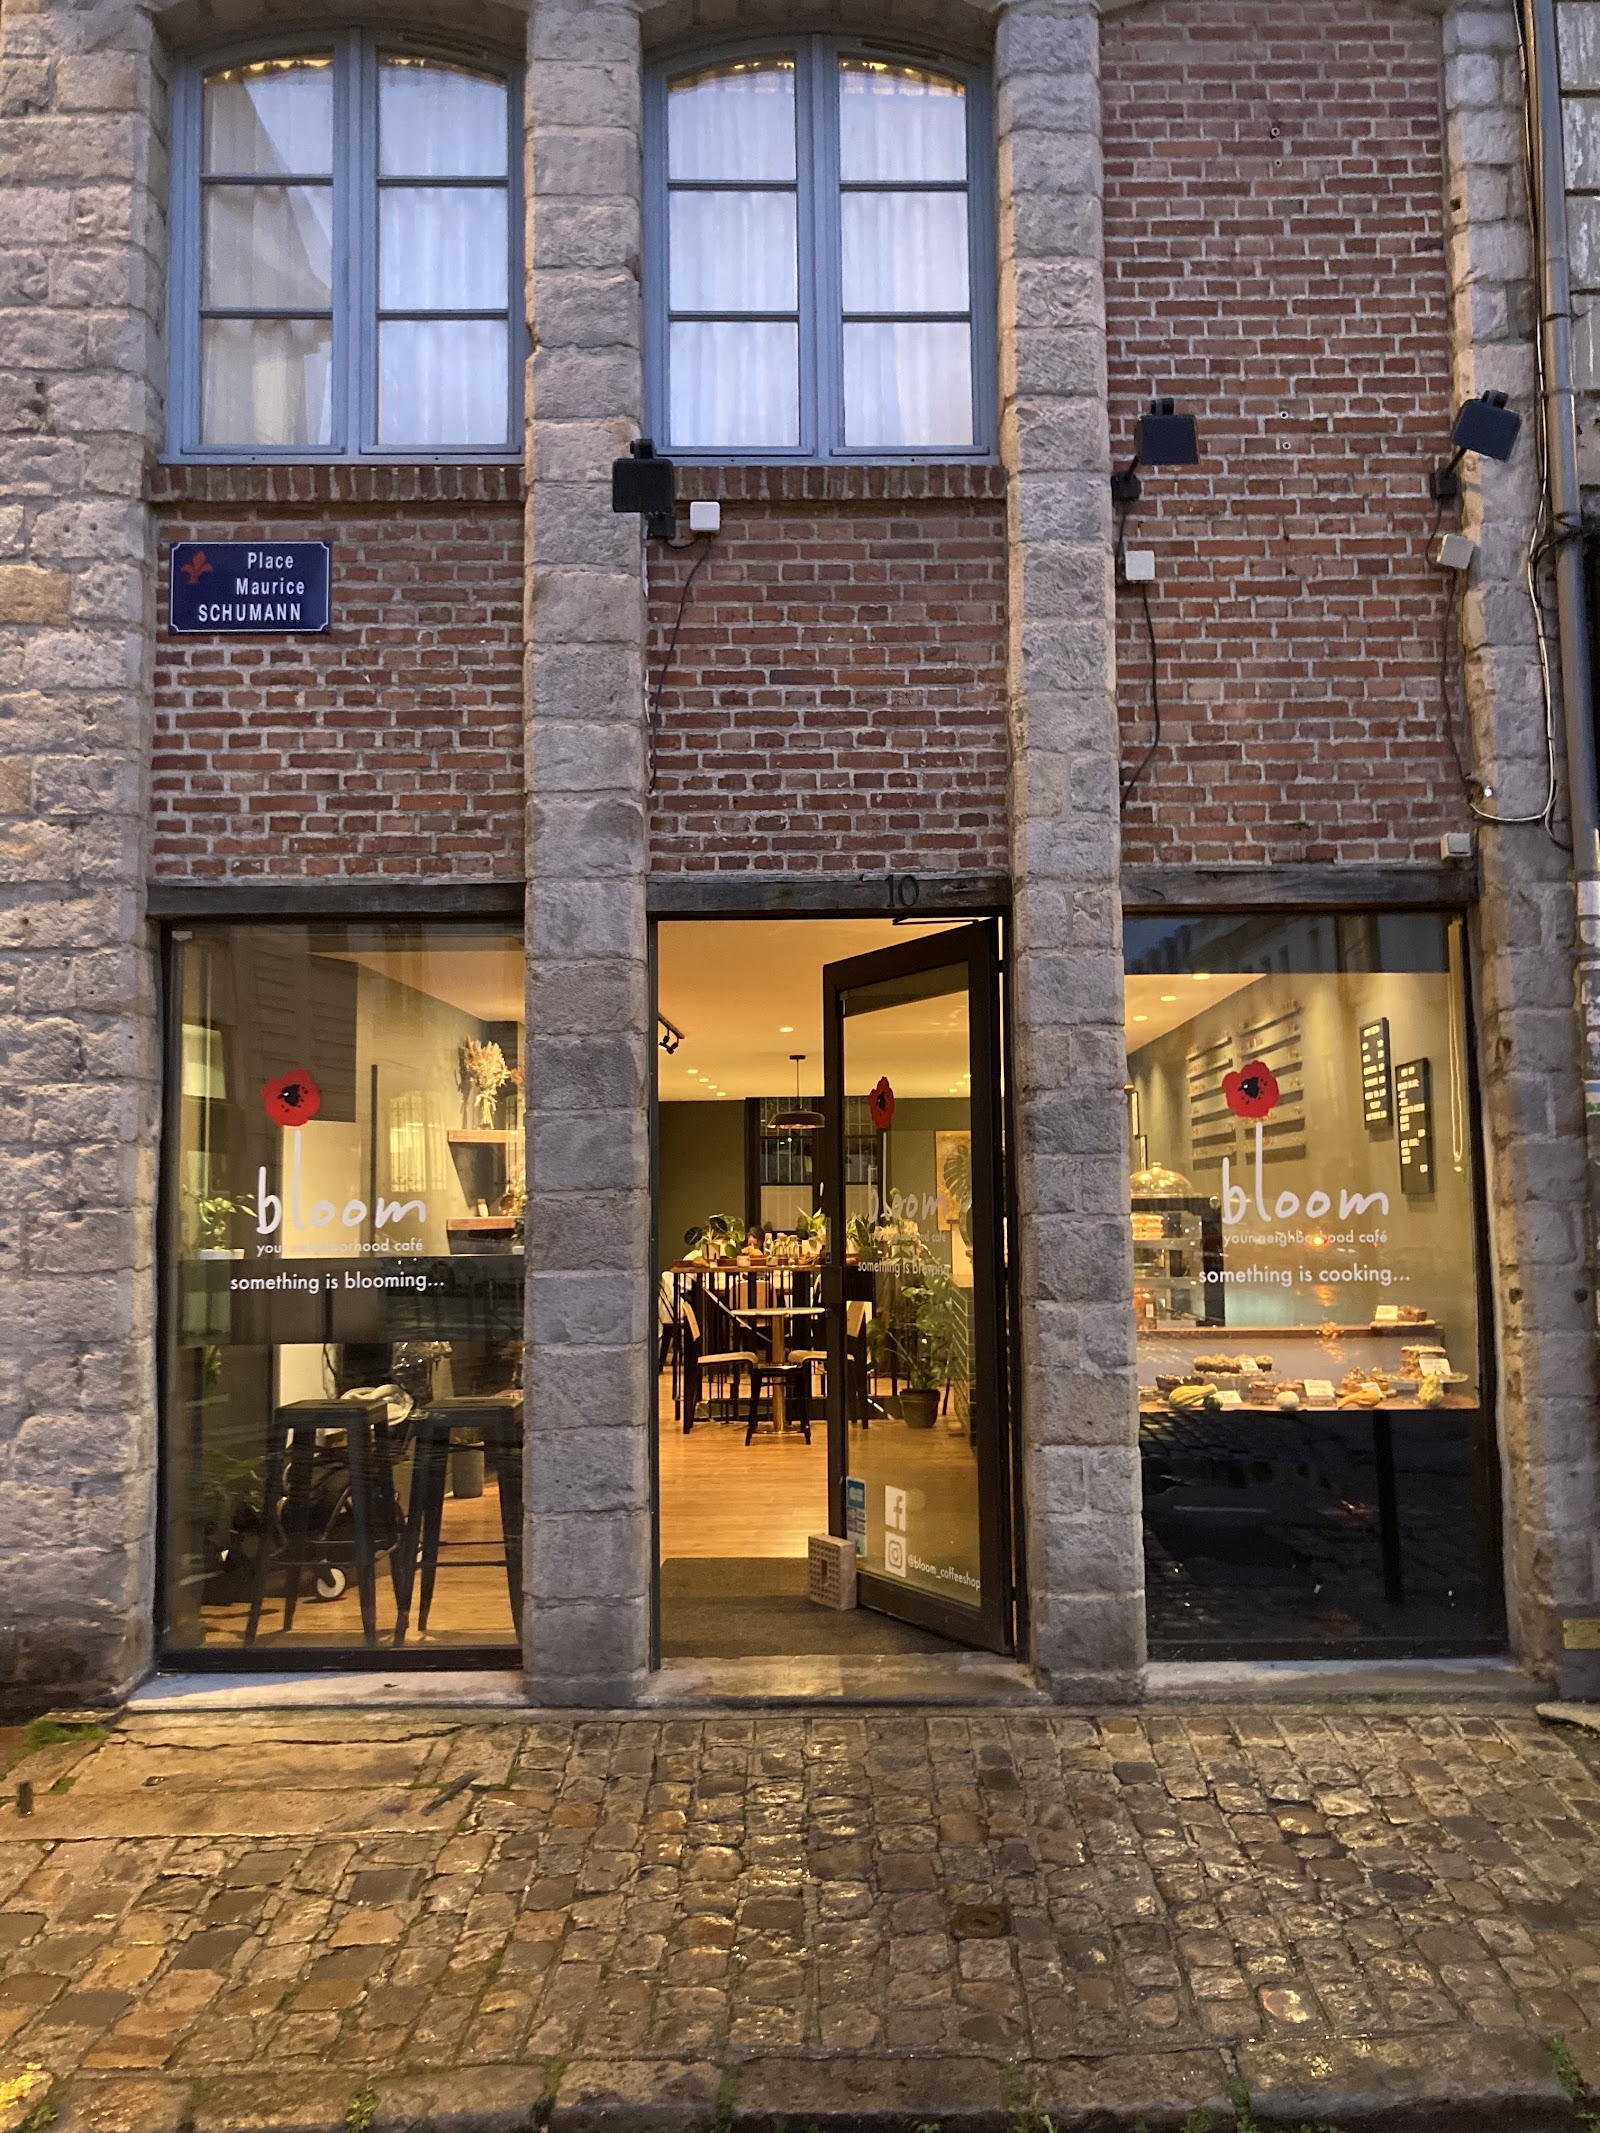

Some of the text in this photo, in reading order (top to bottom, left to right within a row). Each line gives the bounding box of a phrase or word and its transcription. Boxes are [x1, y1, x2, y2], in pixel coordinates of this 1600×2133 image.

[247, 551, 294, 570] Place
[236, 577, 305, 595] Maurice
[198, 603, 301, 622] SCHUMANN
[885, 874, 920, 907] 10
[256, 1130, 427, 1235] bloom
[868, 1132, 948, 1223] bloom
[1221, 1122, 1390, 1225] bloom
[256, 1243, 287, 1257] you
[394, 1237, 423, 1252] café
[1223, 1229, 1388, 1248] your neighbohood café
[857, 1259, 900, 1278] something
[903, 1262, 910, 1273] is
[1199, 1262, 1411, 1288] something is cooking...
[230, 1270, 445, 1294] something is blooming...
[908, 1553, 981, 1592] @bloom_coffeeshop
